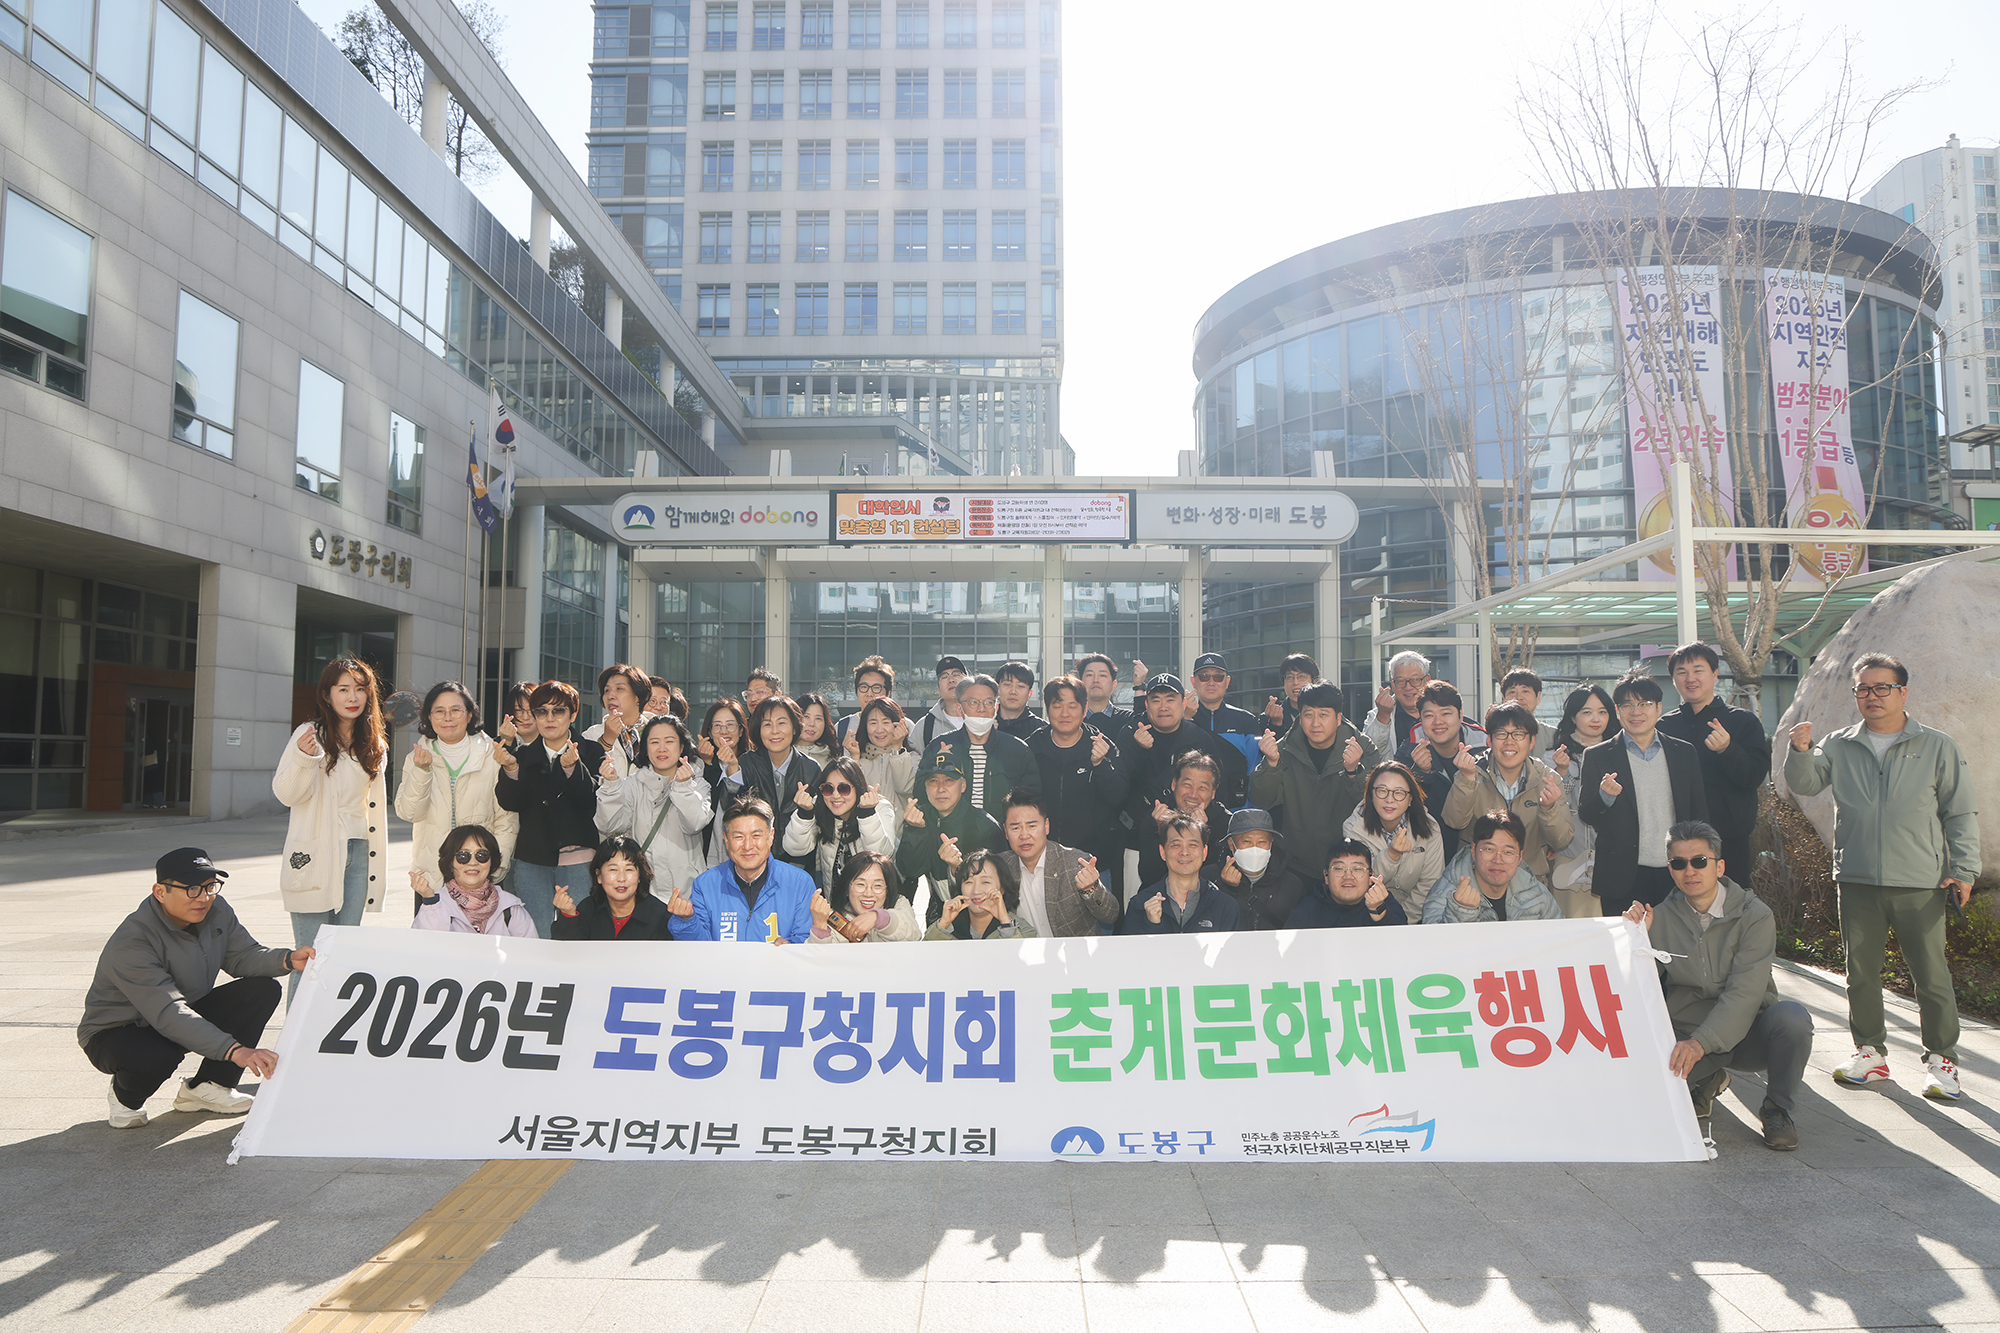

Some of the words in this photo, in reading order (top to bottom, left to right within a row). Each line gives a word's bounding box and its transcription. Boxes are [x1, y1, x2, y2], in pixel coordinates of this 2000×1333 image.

[1781, 429, 1840, 462] 1등급
[665, 505, 735, 529] 함께해요!
[740, 505, 819, 528] dobong
[858, 500, 921, 516] 대학입시
[1288, 505, 1328, 529] 도봉
[839, 519, 886, 535] 맞춤형
[890, 519, 910, 535] 1:1
[913, 519, 961, 535] 컨설팅
[329, 535, 412, 589] 도봉구의회
[719, 921, 738, 942] 김
[763, 912, 781, 943] 1
[318, 972, 576, 1072] 2026년
[592, 986, 1016, 1084] 도봉구청지회
[498, 1114, 741, 1156] 서울지역지부
[755, 1125, 996, 1157] 도봉구청지회
[1118, 1130, 1217, 1156] 도봉구
[1241, 1131, 1280, 1143] 민주노총
[1282, 1129, 1341, 1142] 공공운수노조
[1242, 1138, 1411, 1156] 전국자치단체공무직본부
